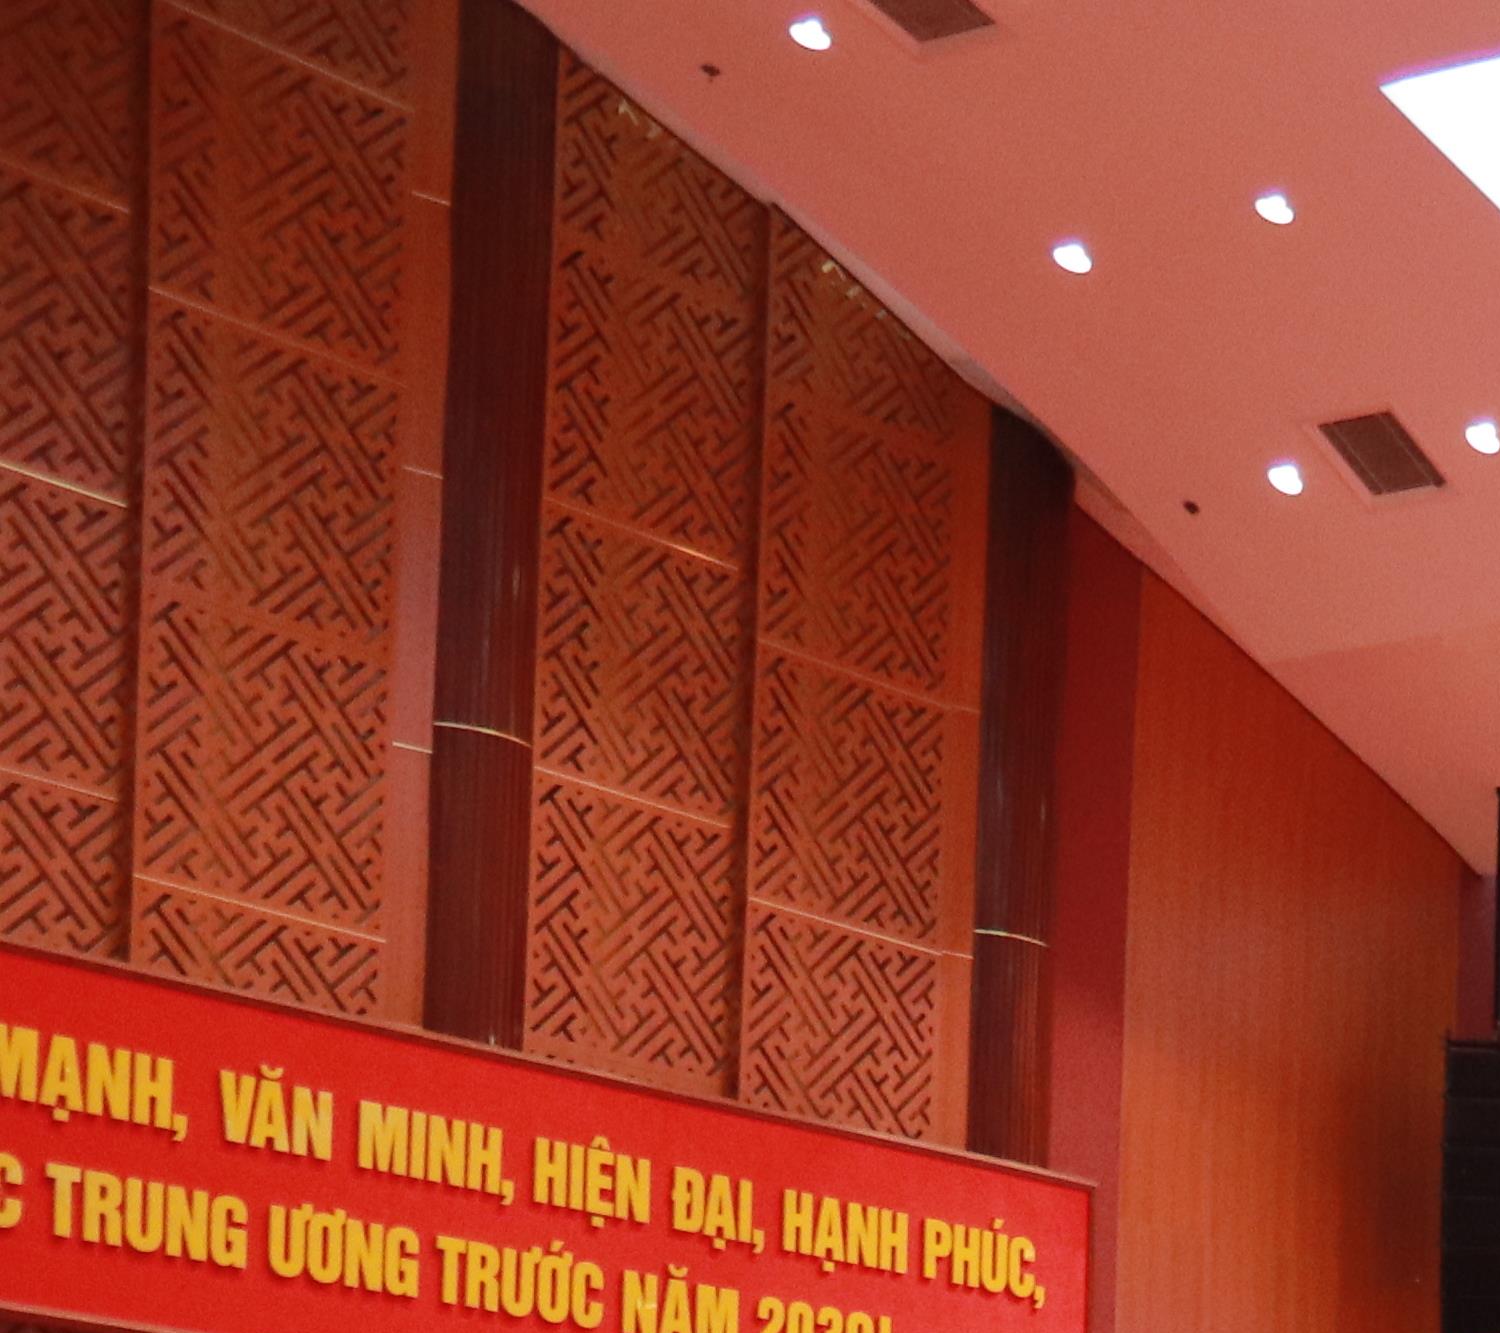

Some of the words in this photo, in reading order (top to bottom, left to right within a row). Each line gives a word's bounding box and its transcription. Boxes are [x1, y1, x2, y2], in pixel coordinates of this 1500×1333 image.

[0, 1024, 187, 1140] MẠNH,
[221, 1067, 332, 1159] VĂN
[359, 1102, 514, 1203] MINH,
[535, 1136, 650, 1226] HIỆN
[673, 1168, 763, 1251] ĐẠI,
[784, 1190, 908, 1272] HẠNH
[924, 1218, 1045, 1306] PHÚC,
[47, 1164, 247, 1267] TRUNG
[270, 1204, 419, 1296] ƯƠNG
[437, 1236, 604, 1328] TRƯỚC
